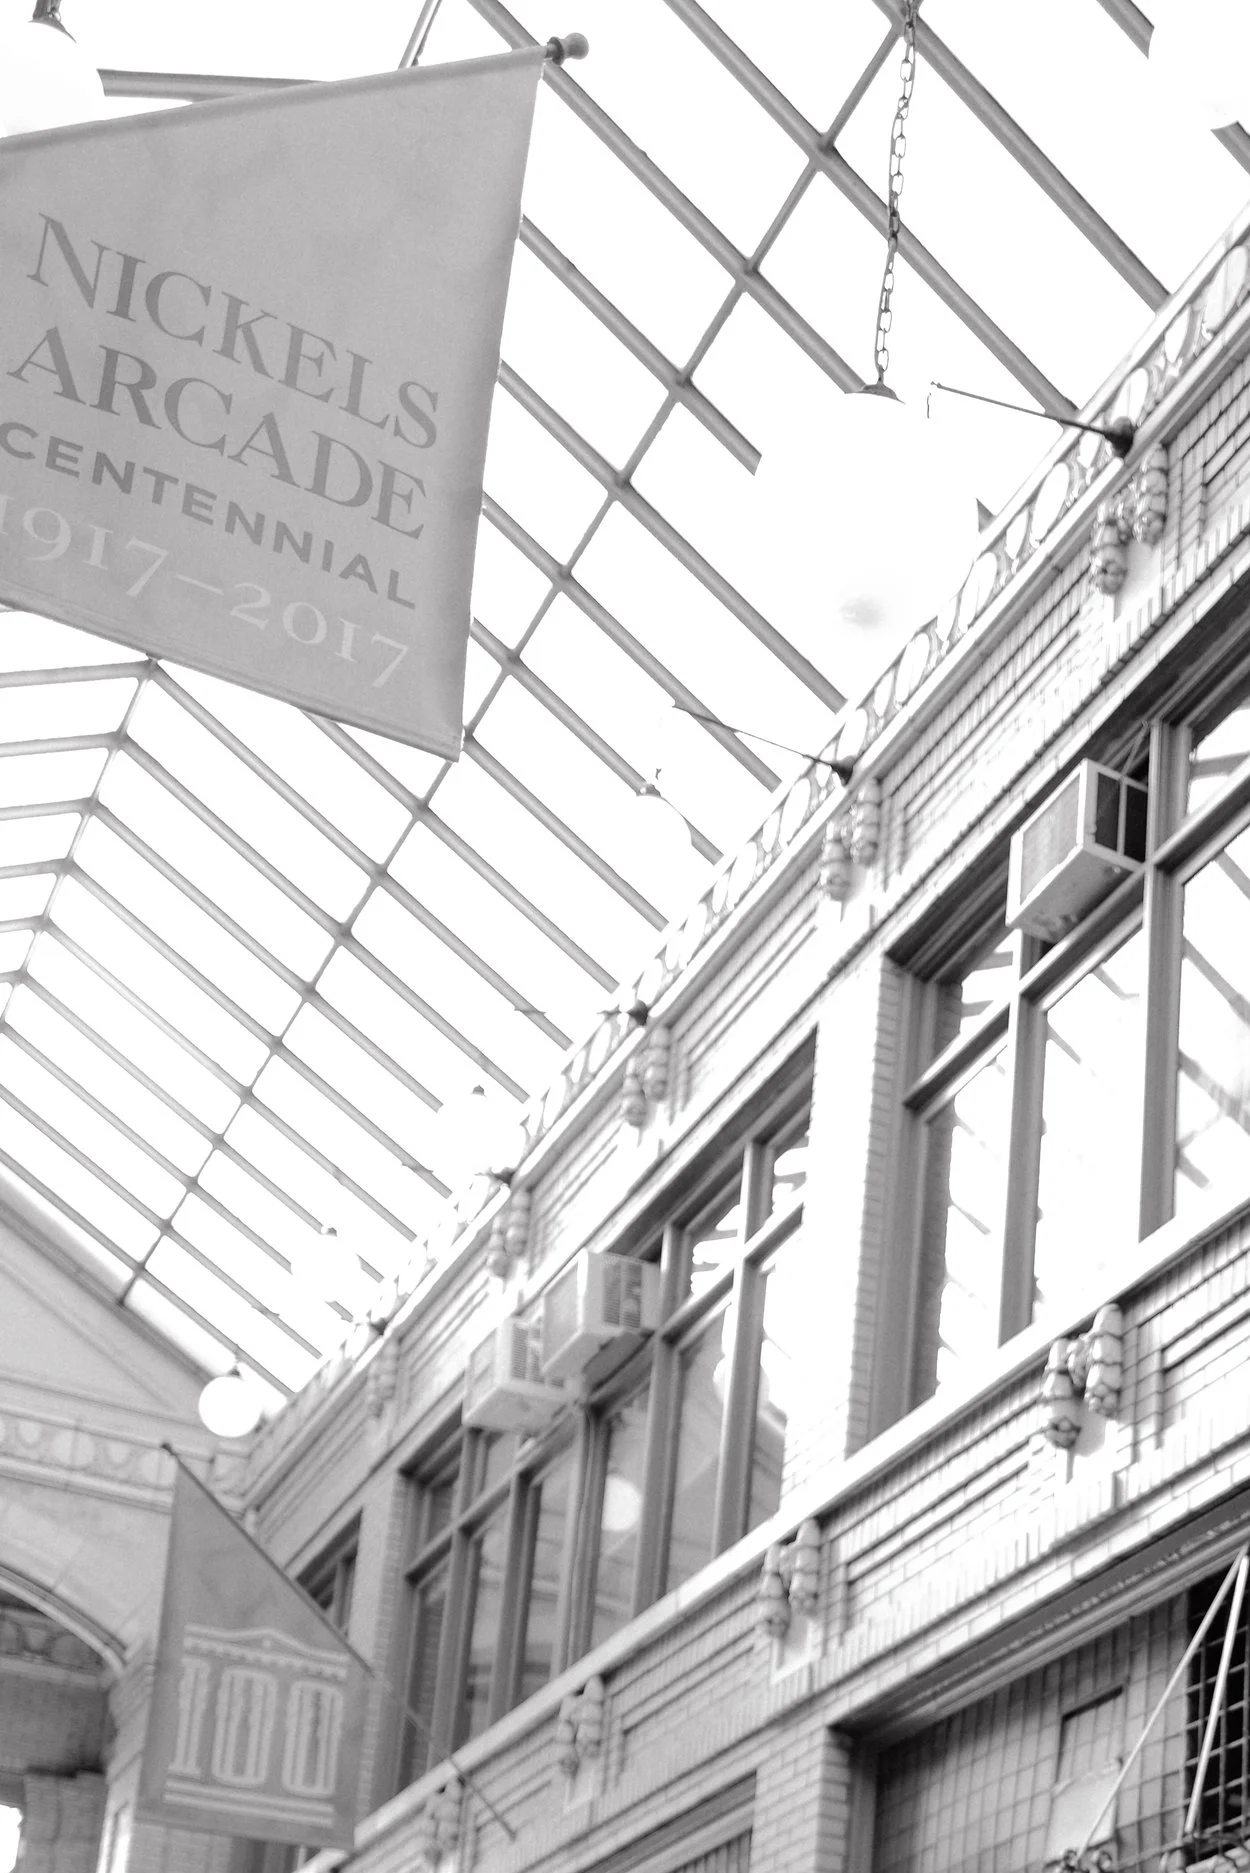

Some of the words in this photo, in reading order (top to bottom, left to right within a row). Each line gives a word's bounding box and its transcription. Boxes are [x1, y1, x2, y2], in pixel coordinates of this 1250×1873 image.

[6, 326, 428, 540] ARCADE
[27, 212, 440, 449] NICKELS
[0, 421, 416, 610] CENTENNIAL
